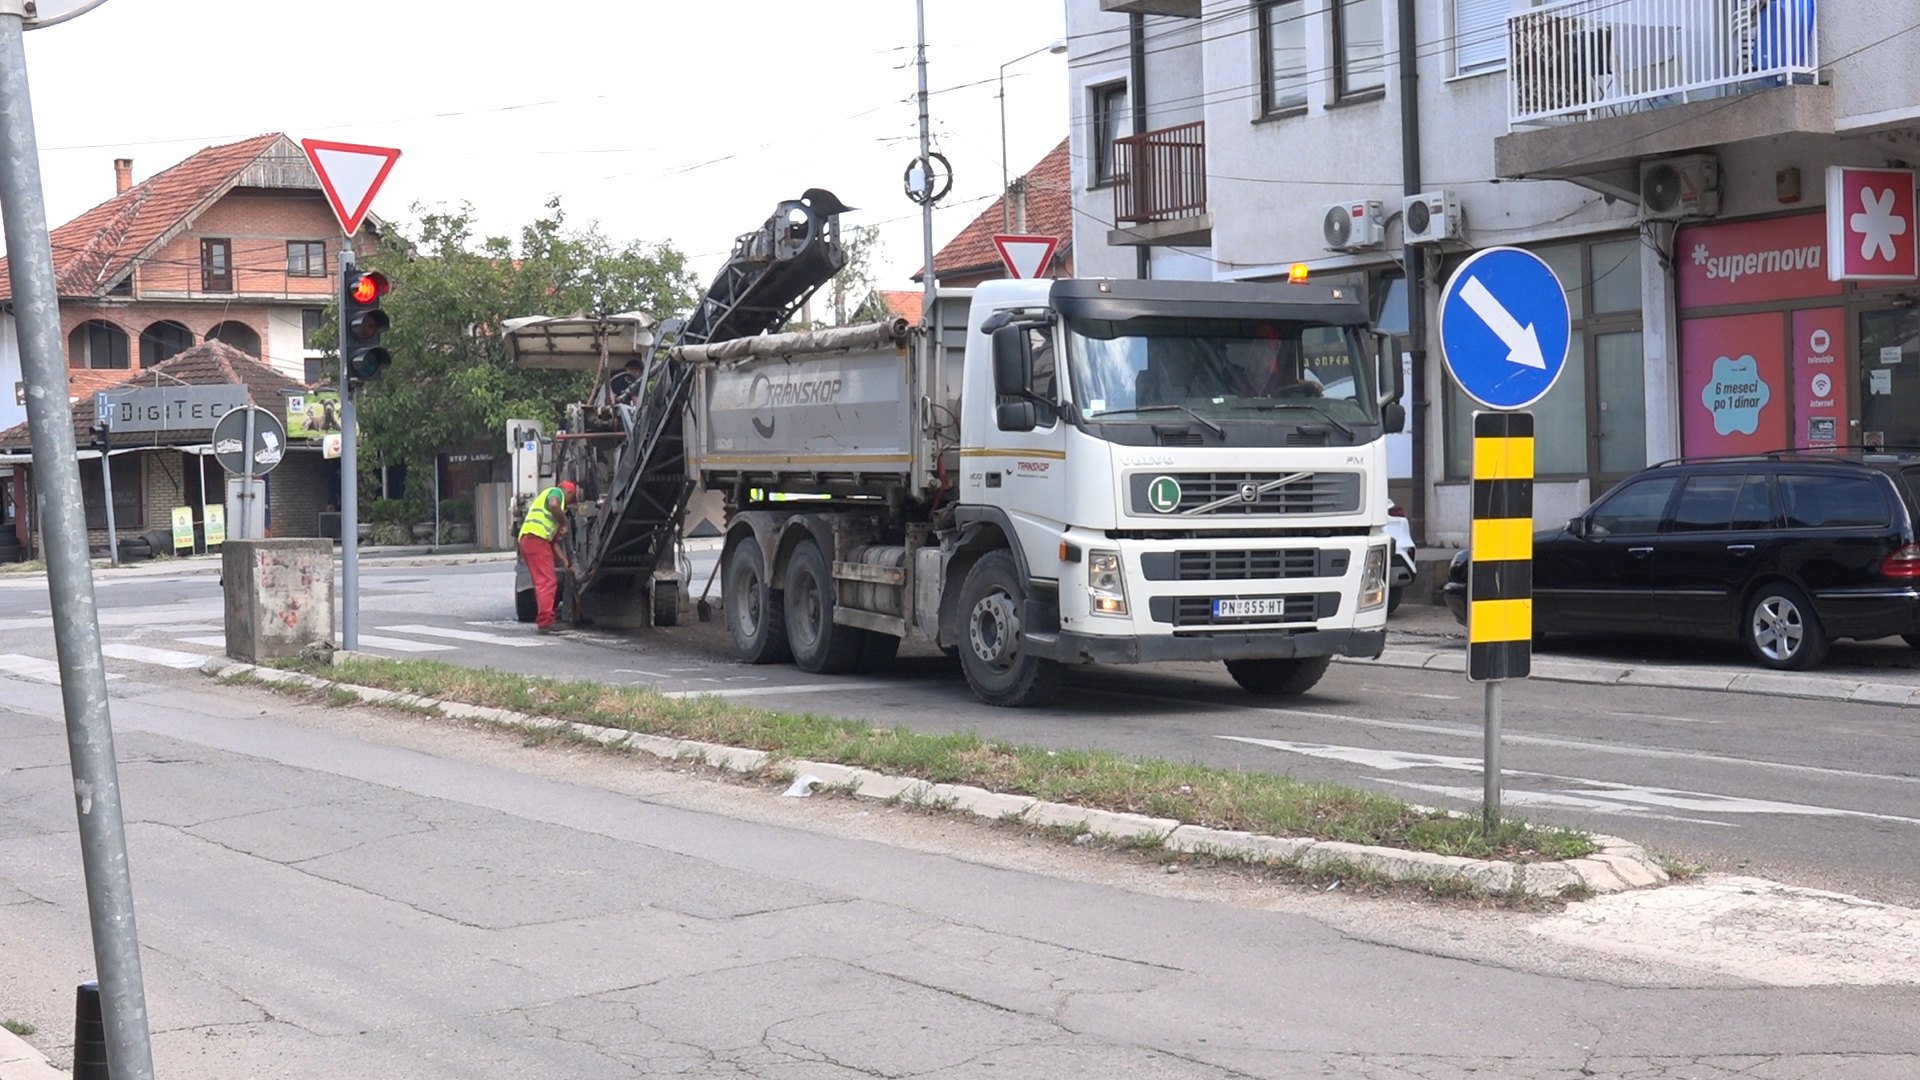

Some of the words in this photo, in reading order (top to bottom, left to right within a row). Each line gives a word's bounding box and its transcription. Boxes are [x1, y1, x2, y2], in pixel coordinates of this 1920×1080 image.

[1706, 246, 1821, 283] supernova
[767, 380, 842, 405] TRANSKOP
[1715, 382, 1722, 395] 6
[1723, 380, 1758, 395] meseci
[1714, 399, 1726, 412] po
[1728, 396, 1733, 409] 1
[1734, 396, 1760, 409] dinar
[1120, 456, 1176, 466] VOLVO
[1158, 483, 1172, 506] L
[1221, 602, 1236, 614] PN
